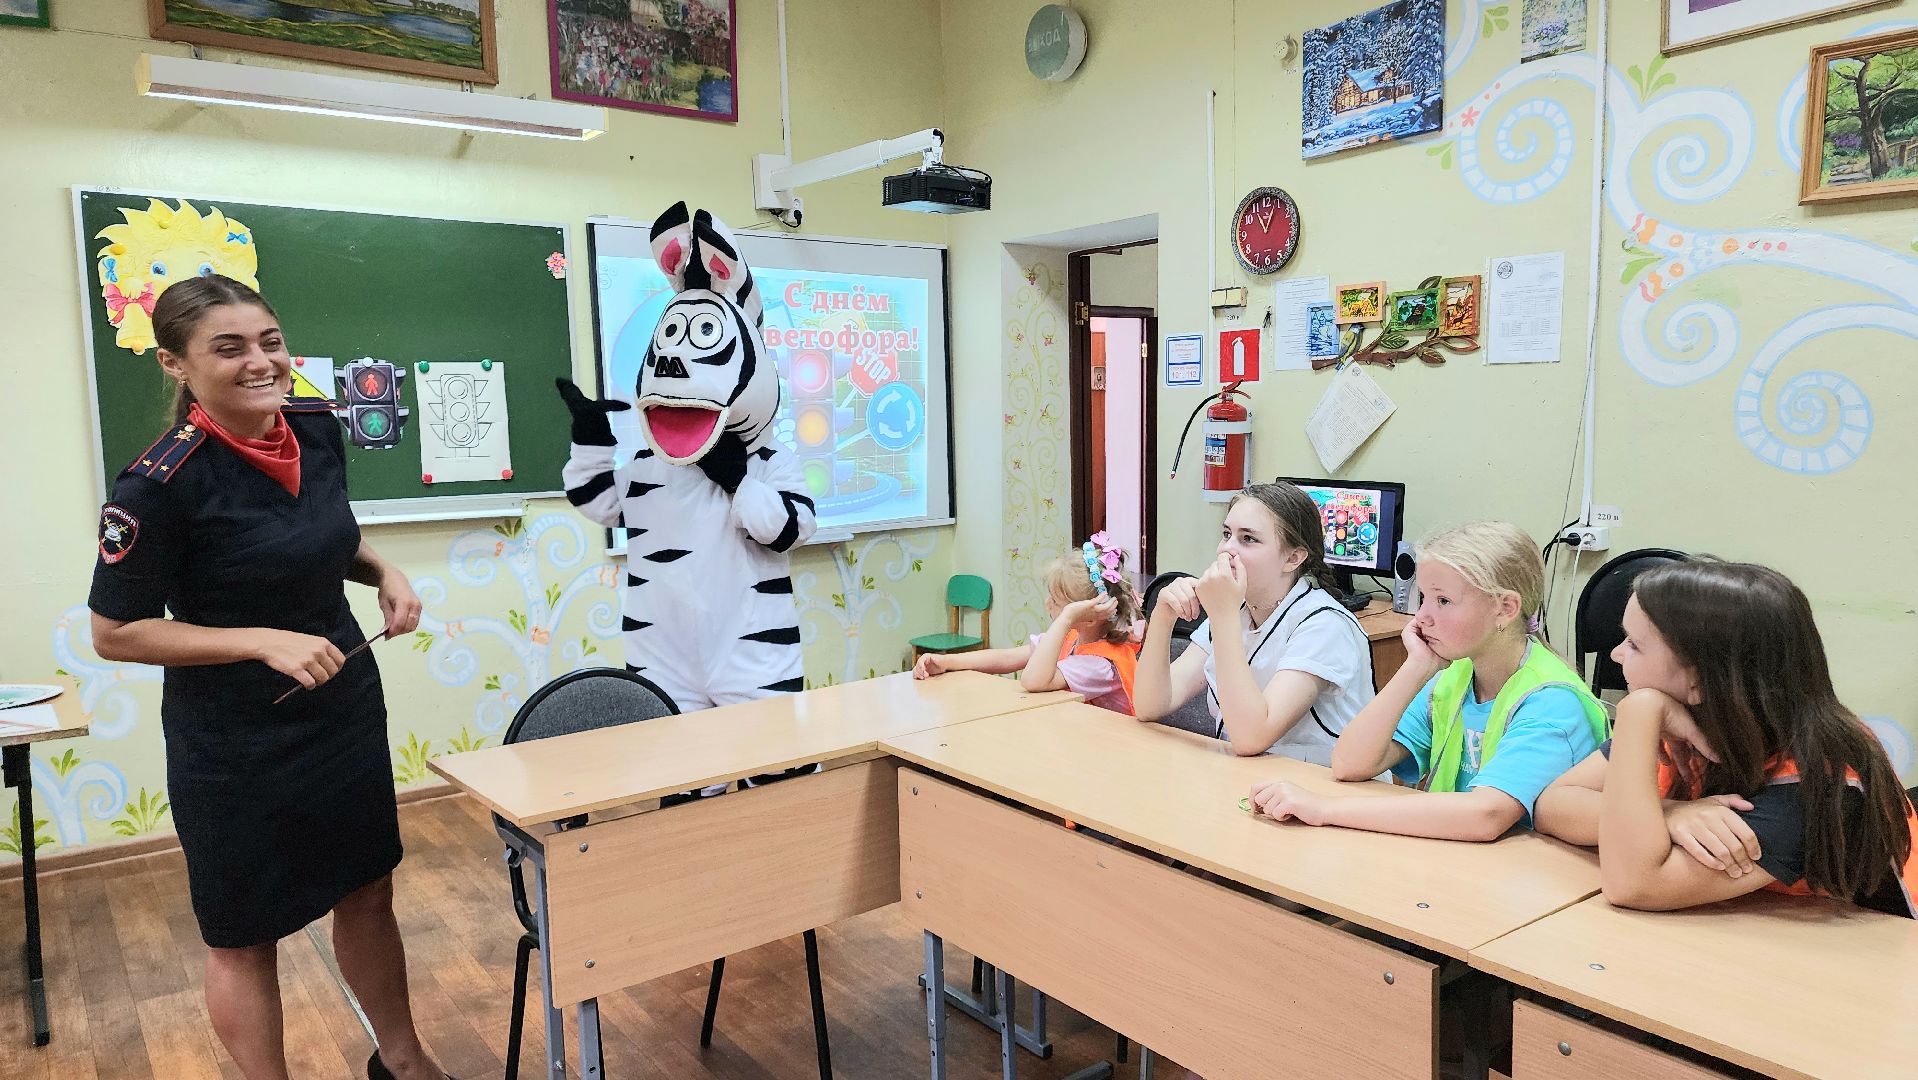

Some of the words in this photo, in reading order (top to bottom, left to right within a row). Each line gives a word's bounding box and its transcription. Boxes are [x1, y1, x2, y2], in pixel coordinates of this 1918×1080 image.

[1252, 202, 1260, 214] 11
[1262, 197, 1272, 208] 12
[1277, 198, 1281, 209] 1
[1244, 213, 1254, 225] 10
[1285, 207, 1290, 219] 2
[1241, 230, 1248, 242] 9
[1245, 243, 1252, 255] 8
[1276, 249, 1283, 261] 5
[1253, 252, 1260, 263] 7
[1264, 254, 1271, 266] 6
[784, 282, 803, 308] С
[812, 285, 889, 314] днём
[764, 323, 918, 355] ветофора!
[856, 349, 891, 385] STOP
